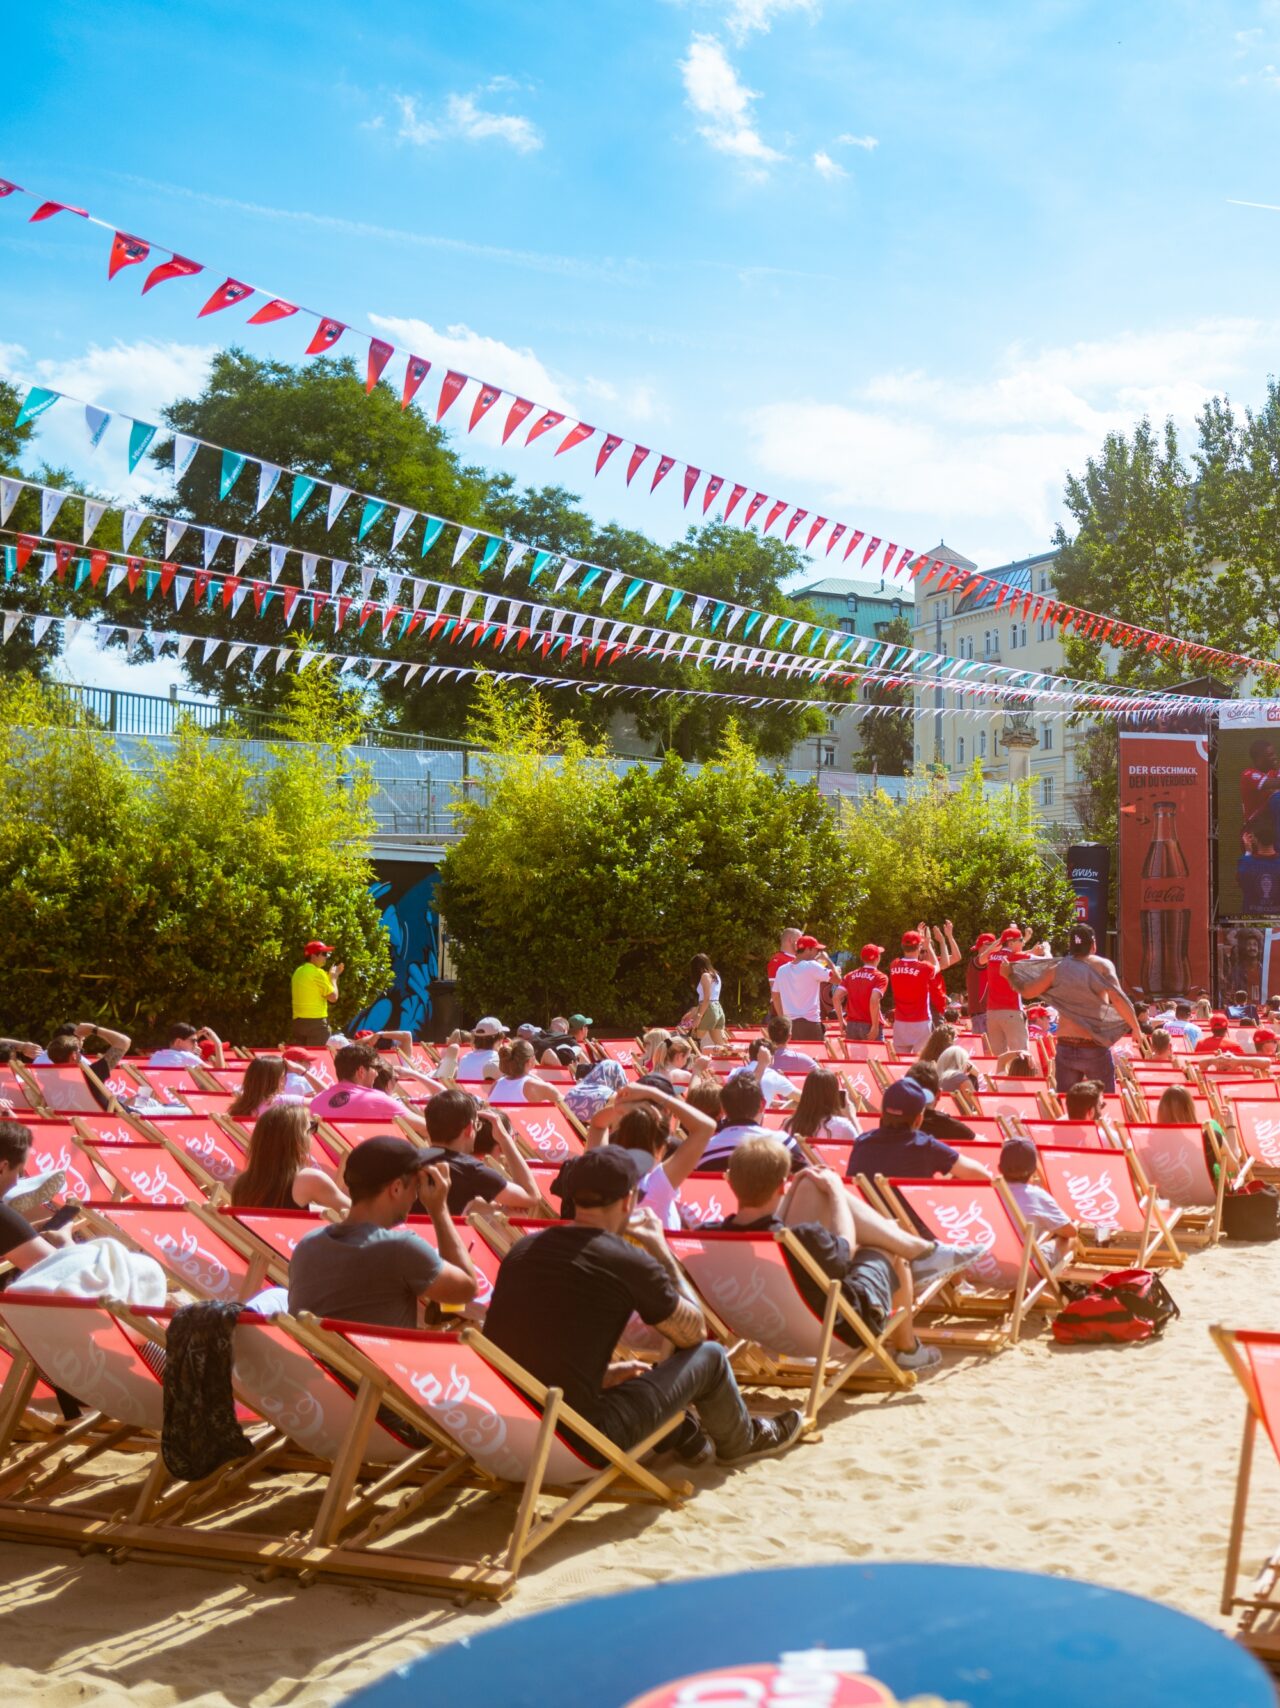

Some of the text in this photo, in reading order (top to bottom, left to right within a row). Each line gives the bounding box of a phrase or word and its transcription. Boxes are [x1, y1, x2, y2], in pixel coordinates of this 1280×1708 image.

[24, 393, 58, 418] Hisense
[132, 427, 155, 461] Hisense
[1129, 765, 1198, 776] DER GESCHMACK,
[1129, 775, 1146, 788] DEN
[1148, 776, 1159, 787] DU
[890, 966, 920, 976] SUISSE
